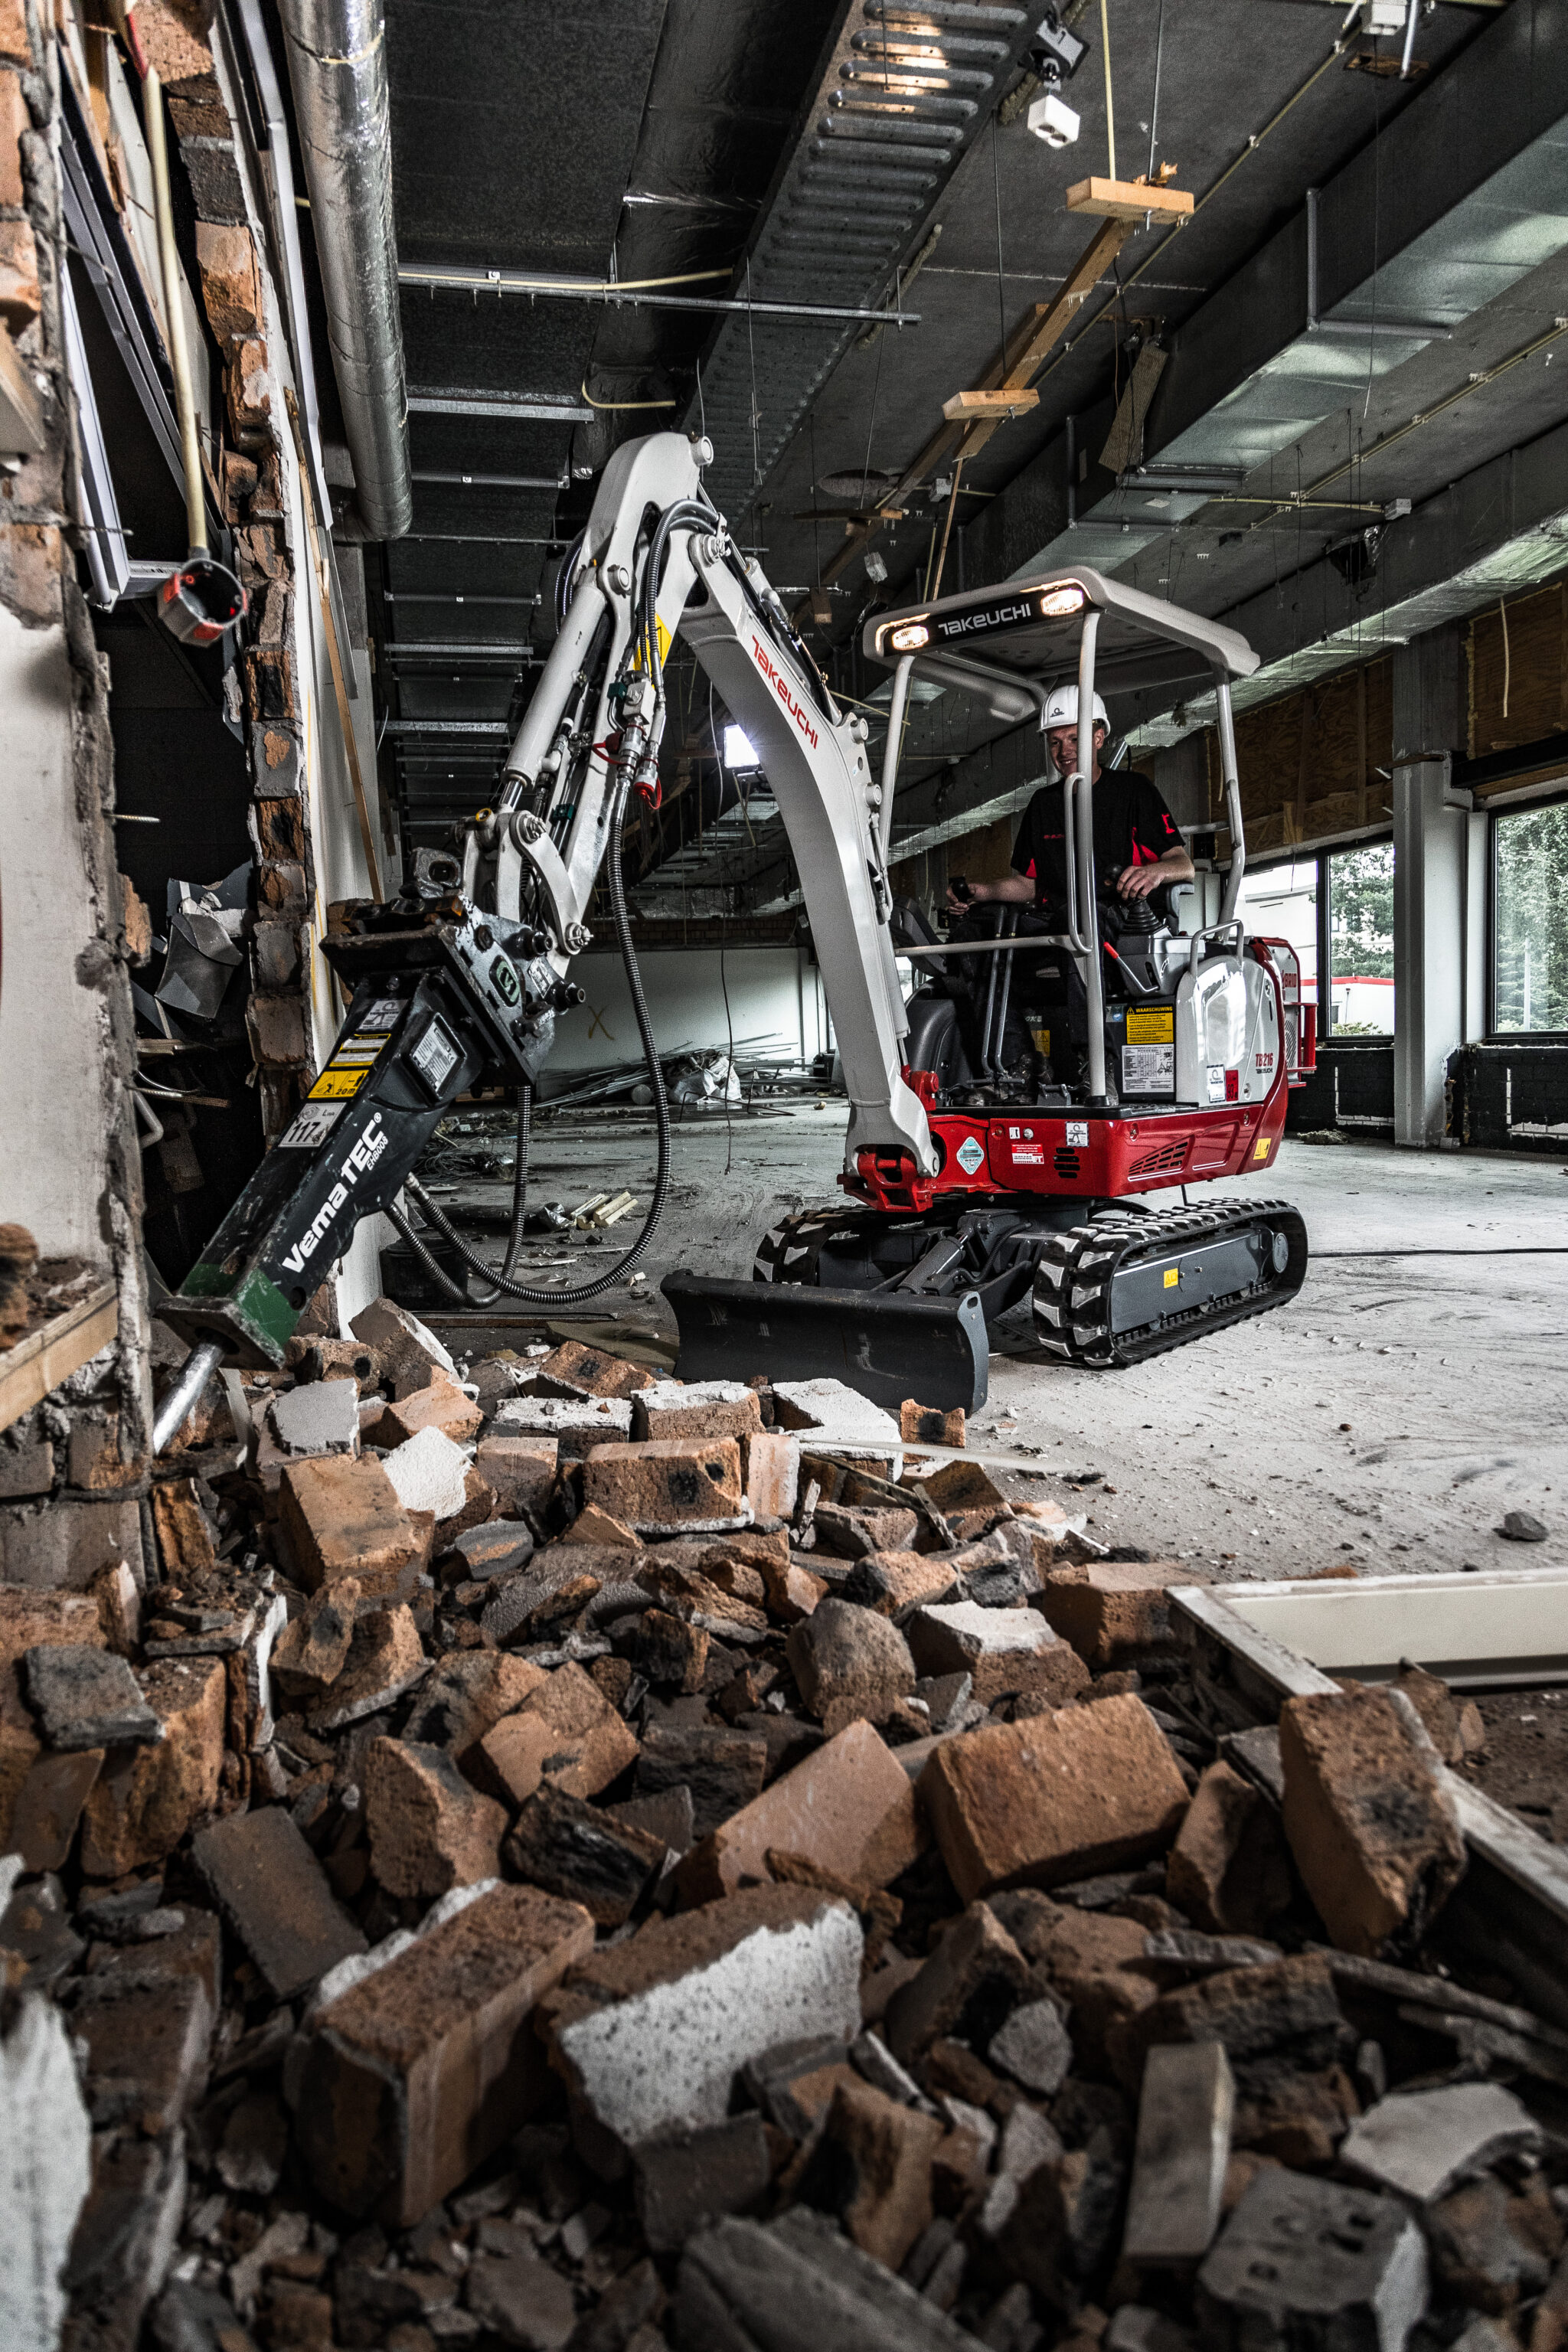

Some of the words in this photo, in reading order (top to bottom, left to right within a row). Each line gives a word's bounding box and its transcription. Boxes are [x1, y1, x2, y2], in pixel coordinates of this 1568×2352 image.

[938, 603, 1031, 635] TAKEUCHI
[752, 634, 818, 750] TAKEUCHI
[1280, 969, 1296, 989] YBRID
[289, 1122, 321, 1142] 117
[366, 1135, 389, 1171] EHB008
